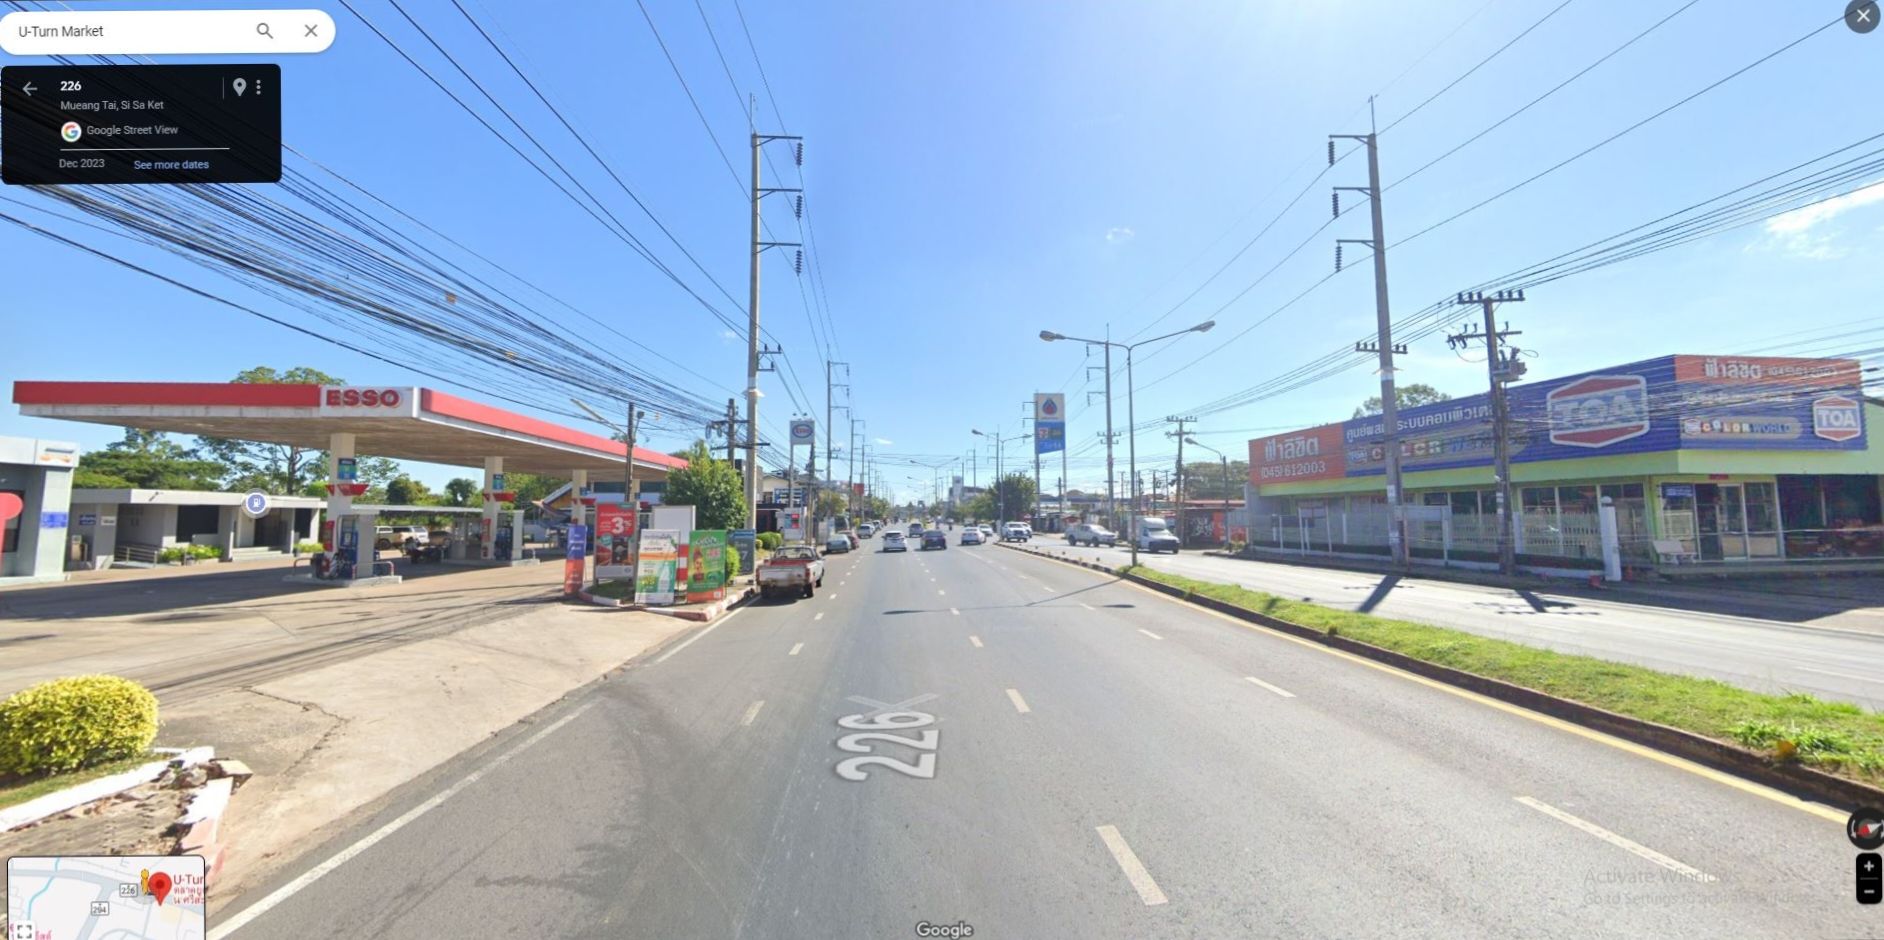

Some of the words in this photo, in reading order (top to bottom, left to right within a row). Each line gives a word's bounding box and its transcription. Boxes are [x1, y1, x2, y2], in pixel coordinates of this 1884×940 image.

[326, 389, 401, 408] ESSO
[1819, 409, 1857, 428] TOA
[1371, 440, 1442, 461] CLOR
